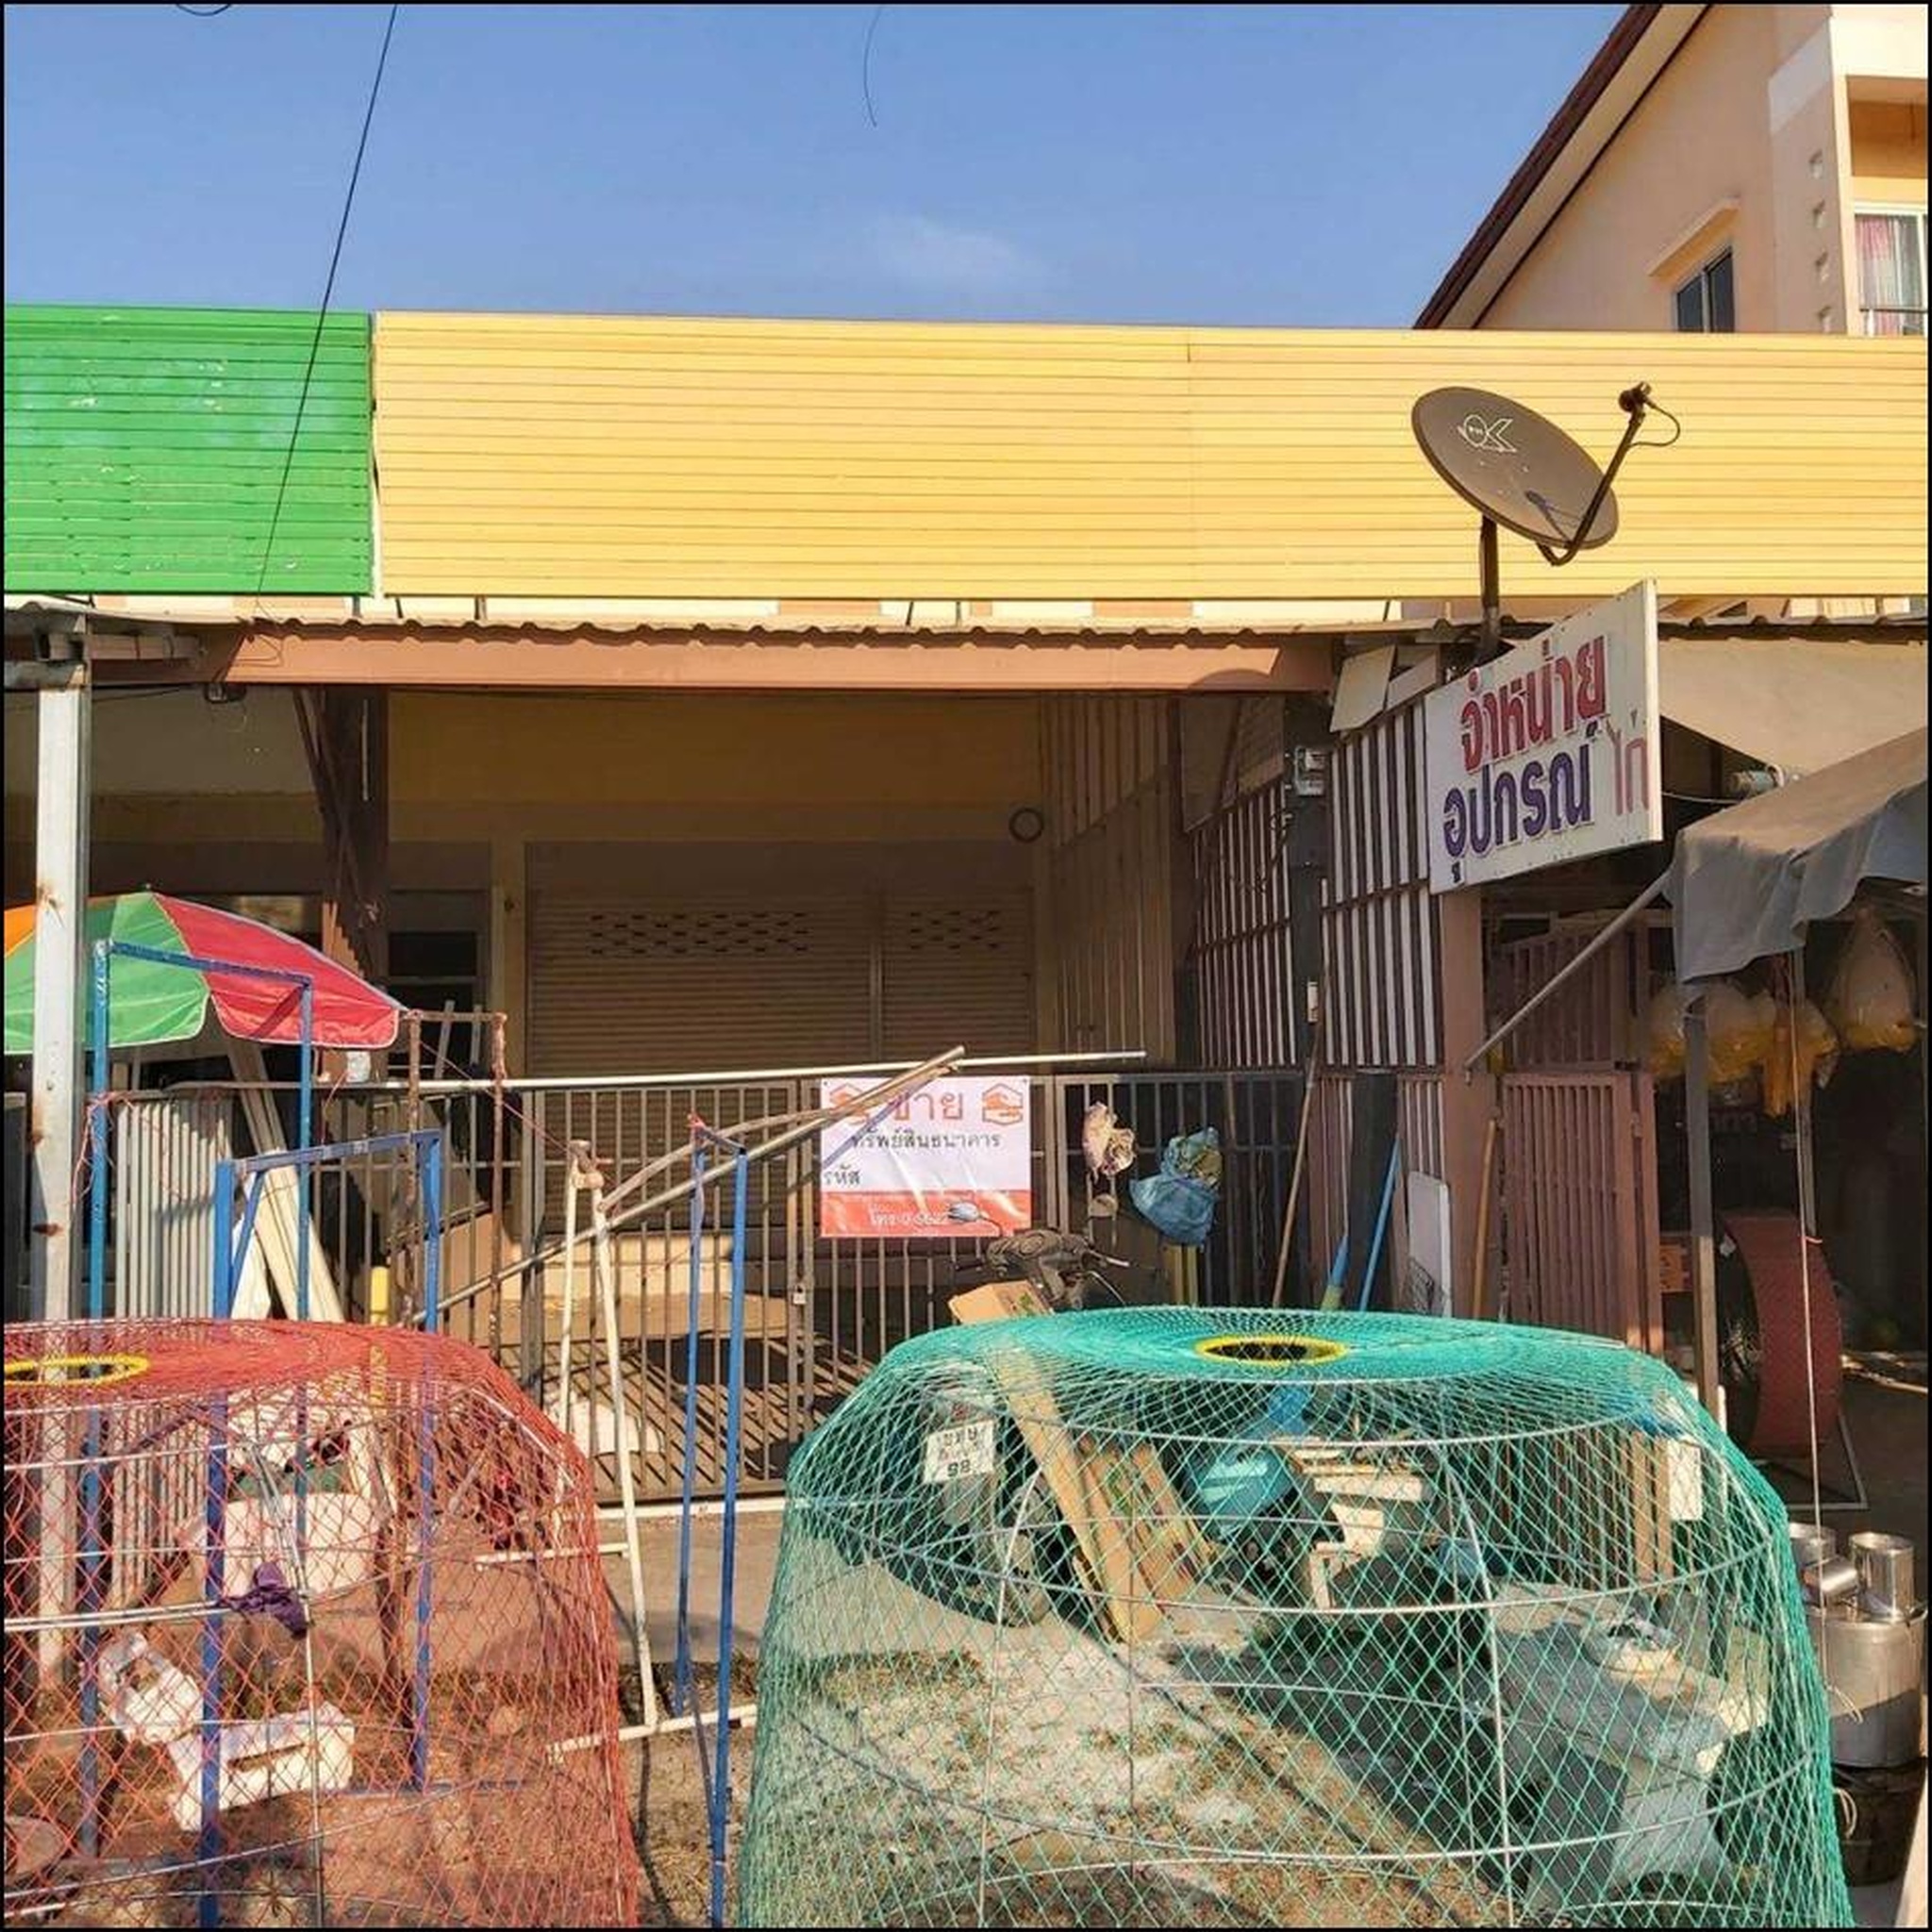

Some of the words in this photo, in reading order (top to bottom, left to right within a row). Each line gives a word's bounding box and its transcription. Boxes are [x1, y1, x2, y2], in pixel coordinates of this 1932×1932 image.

[1461, 636, 1607, 774] จำหน่าย
[1443, 720, 1600, 884] อุปกรณ์
